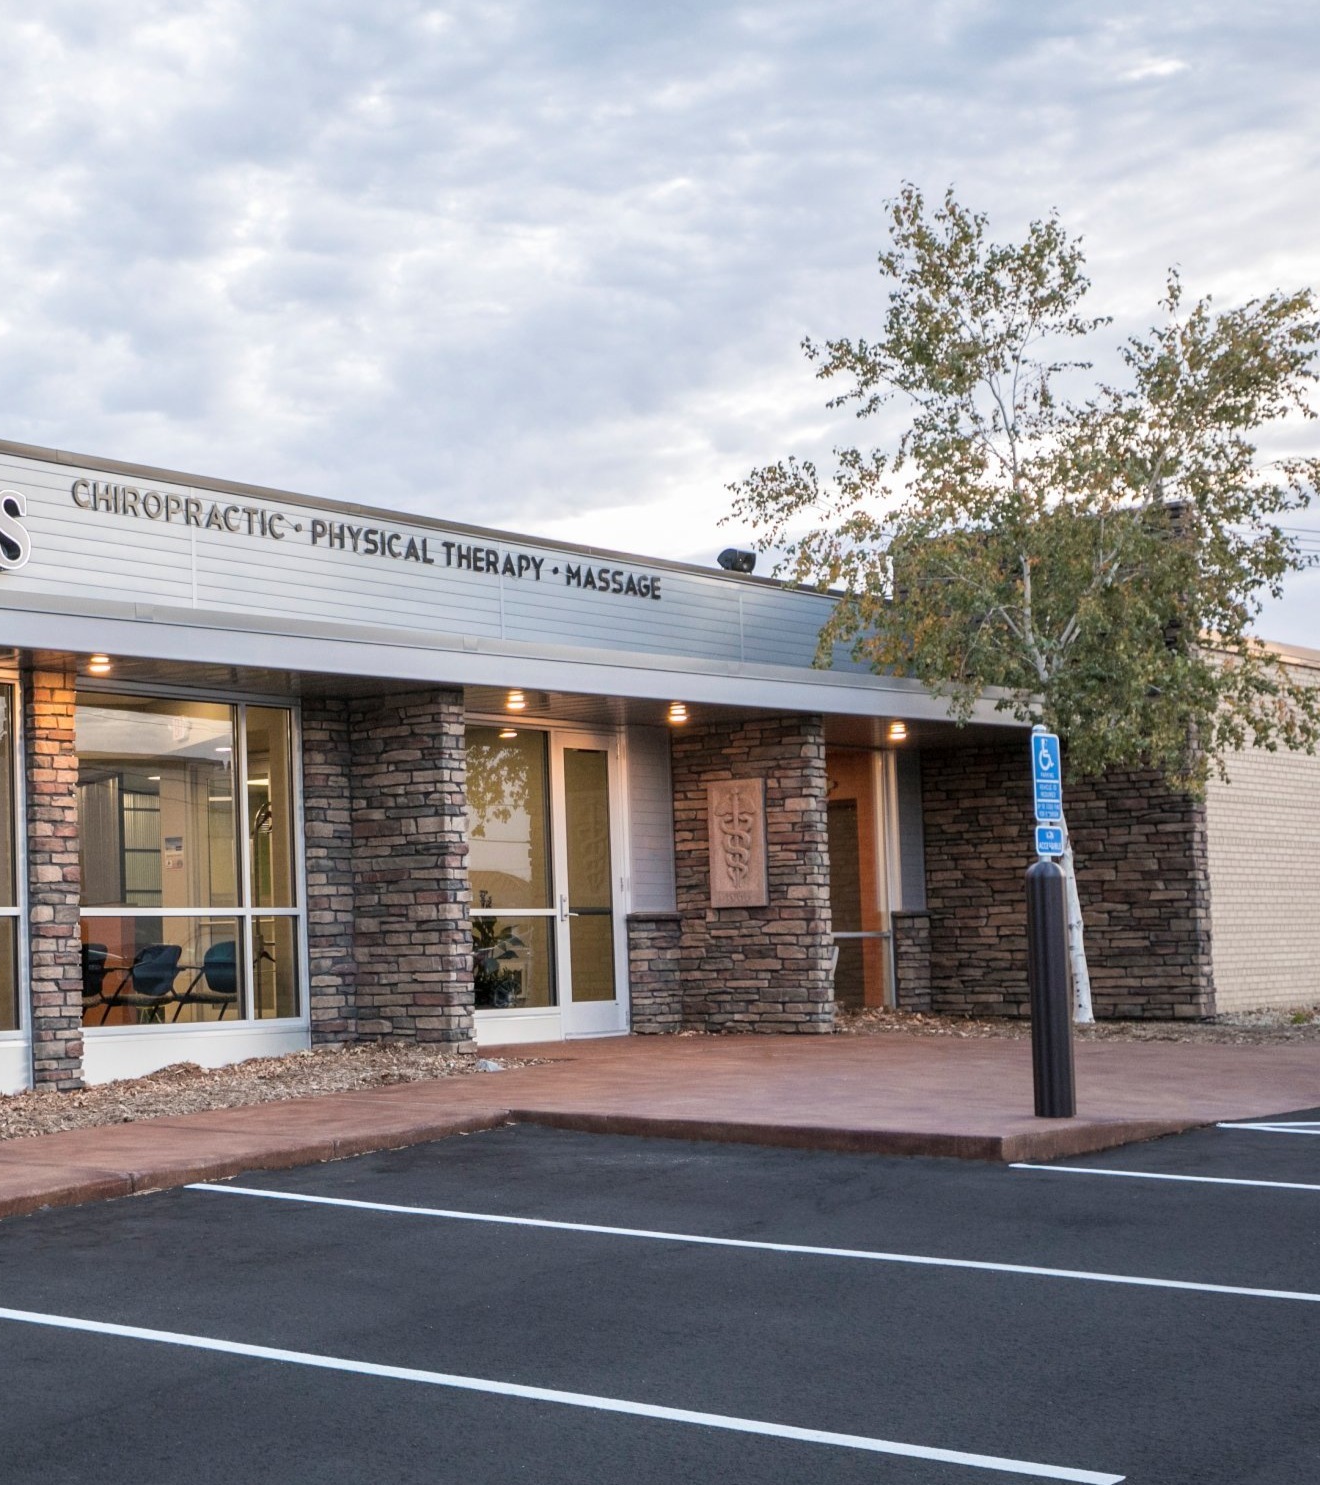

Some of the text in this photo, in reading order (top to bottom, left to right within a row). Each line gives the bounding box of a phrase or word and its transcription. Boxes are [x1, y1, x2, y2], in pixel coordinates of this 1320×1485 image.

[72, 478, 662, 600] CHIROPRACTIC PHYSICAL THERAPY MASSAGE
